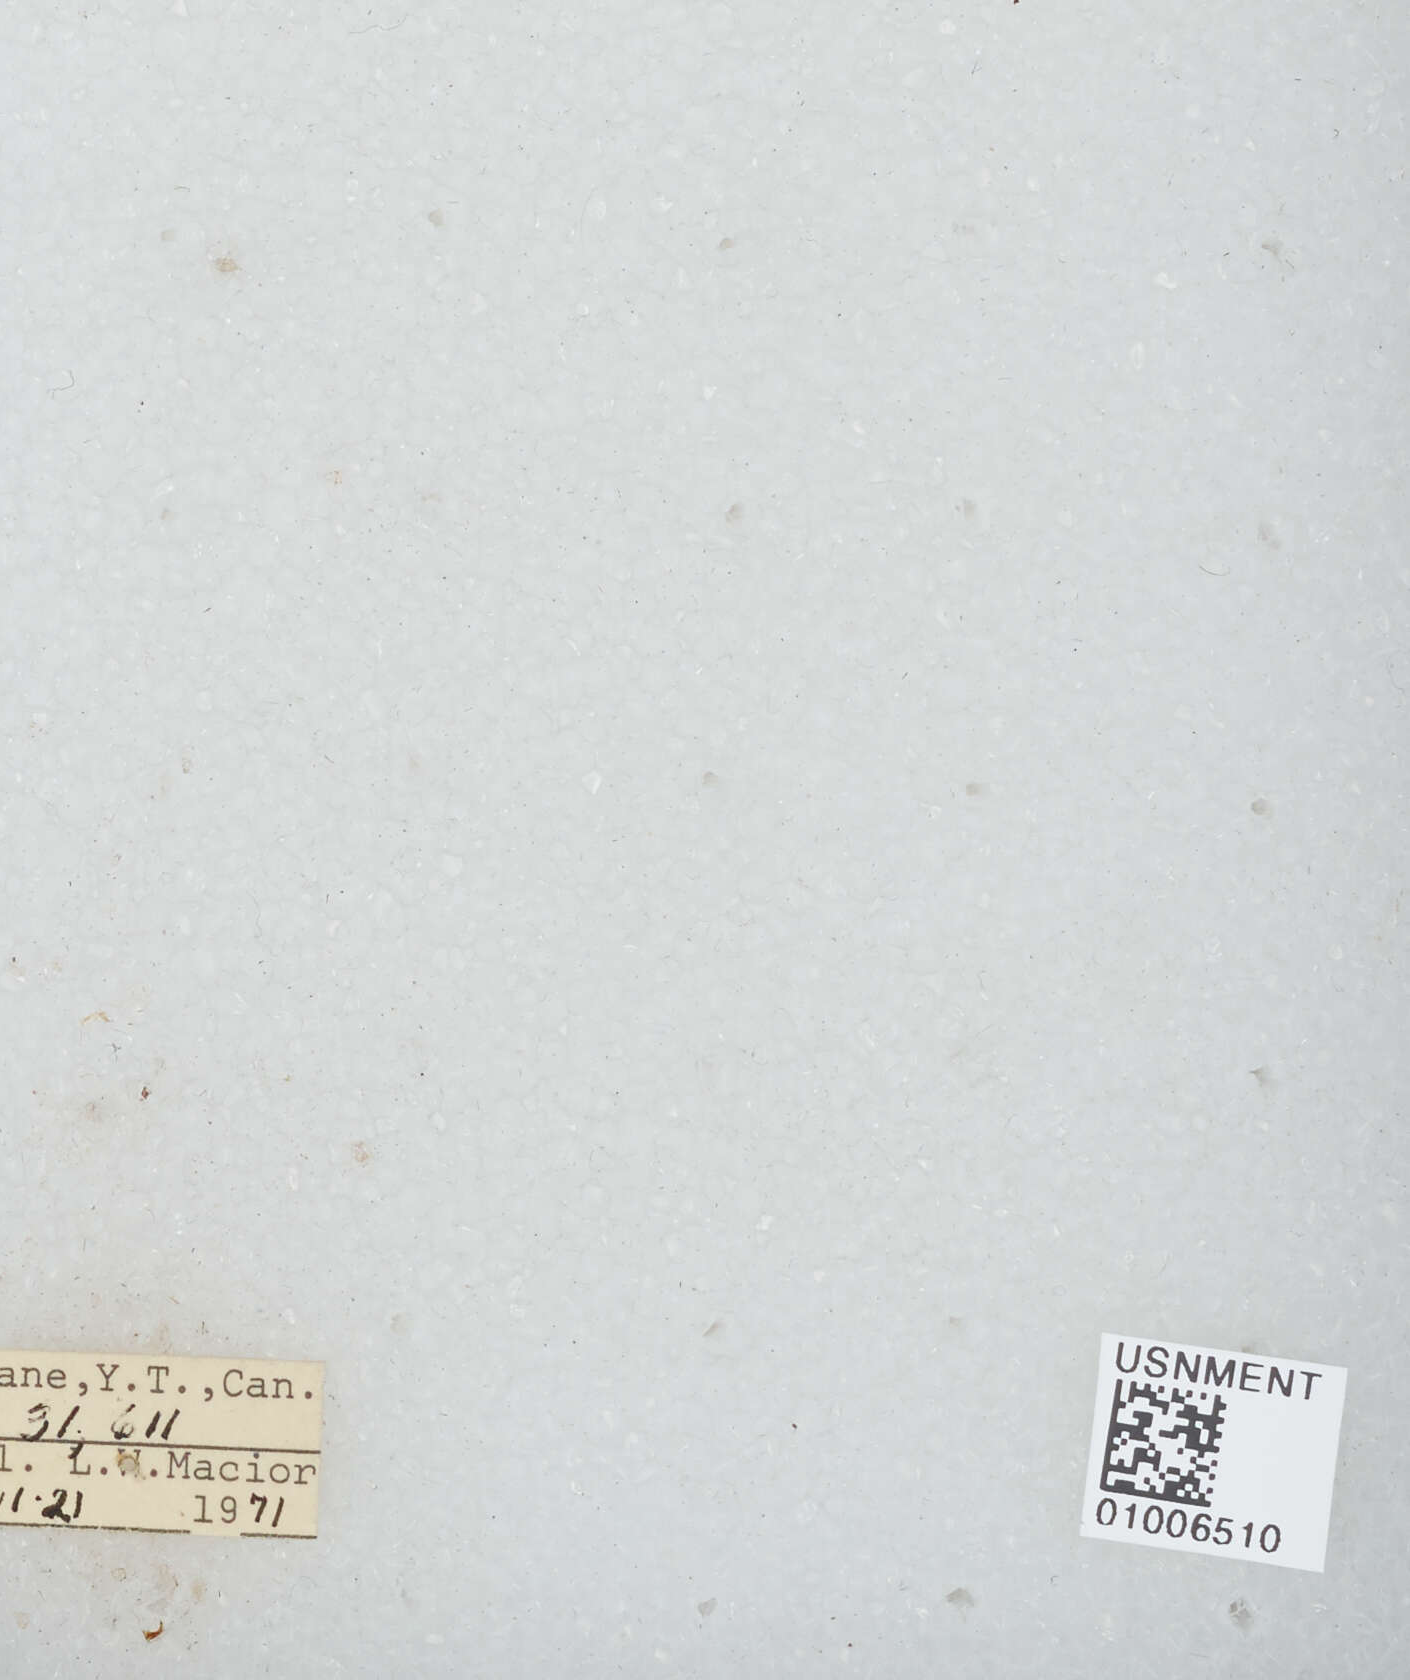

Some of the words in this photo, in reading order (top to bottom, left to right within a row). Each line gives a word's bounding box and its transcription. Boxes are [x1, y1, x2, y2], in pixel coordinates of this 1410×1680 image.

[1115, 1341, 1323, 1400] USNMENT
[192, 1494, 285, 1528] 1971
[1095, 1497, 1282, 1553] 01006510
